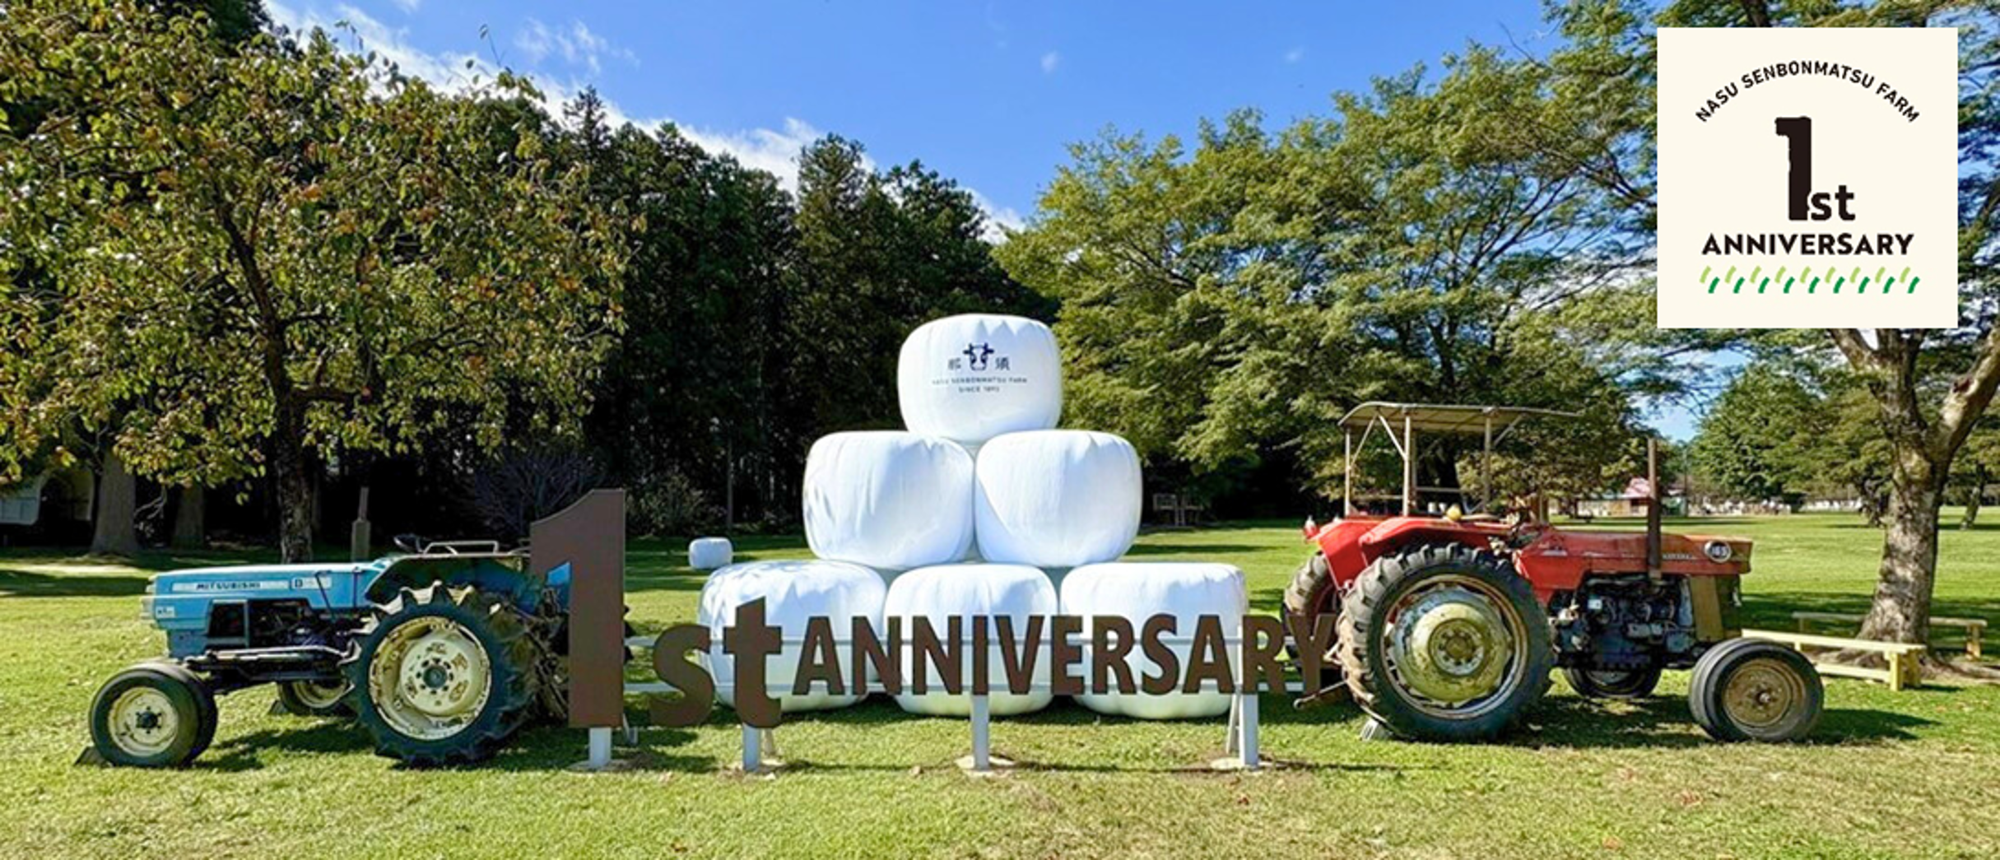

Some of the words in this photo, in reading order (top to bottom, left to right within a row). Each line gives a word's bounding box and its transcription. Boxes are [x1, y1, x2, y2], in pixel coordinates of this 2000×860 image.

[196, 582, 261, 590] MITSUBISHI
[530, 488, 783, 729] 1st
[792, 614, 1337, 695] ANNIVERSARY
